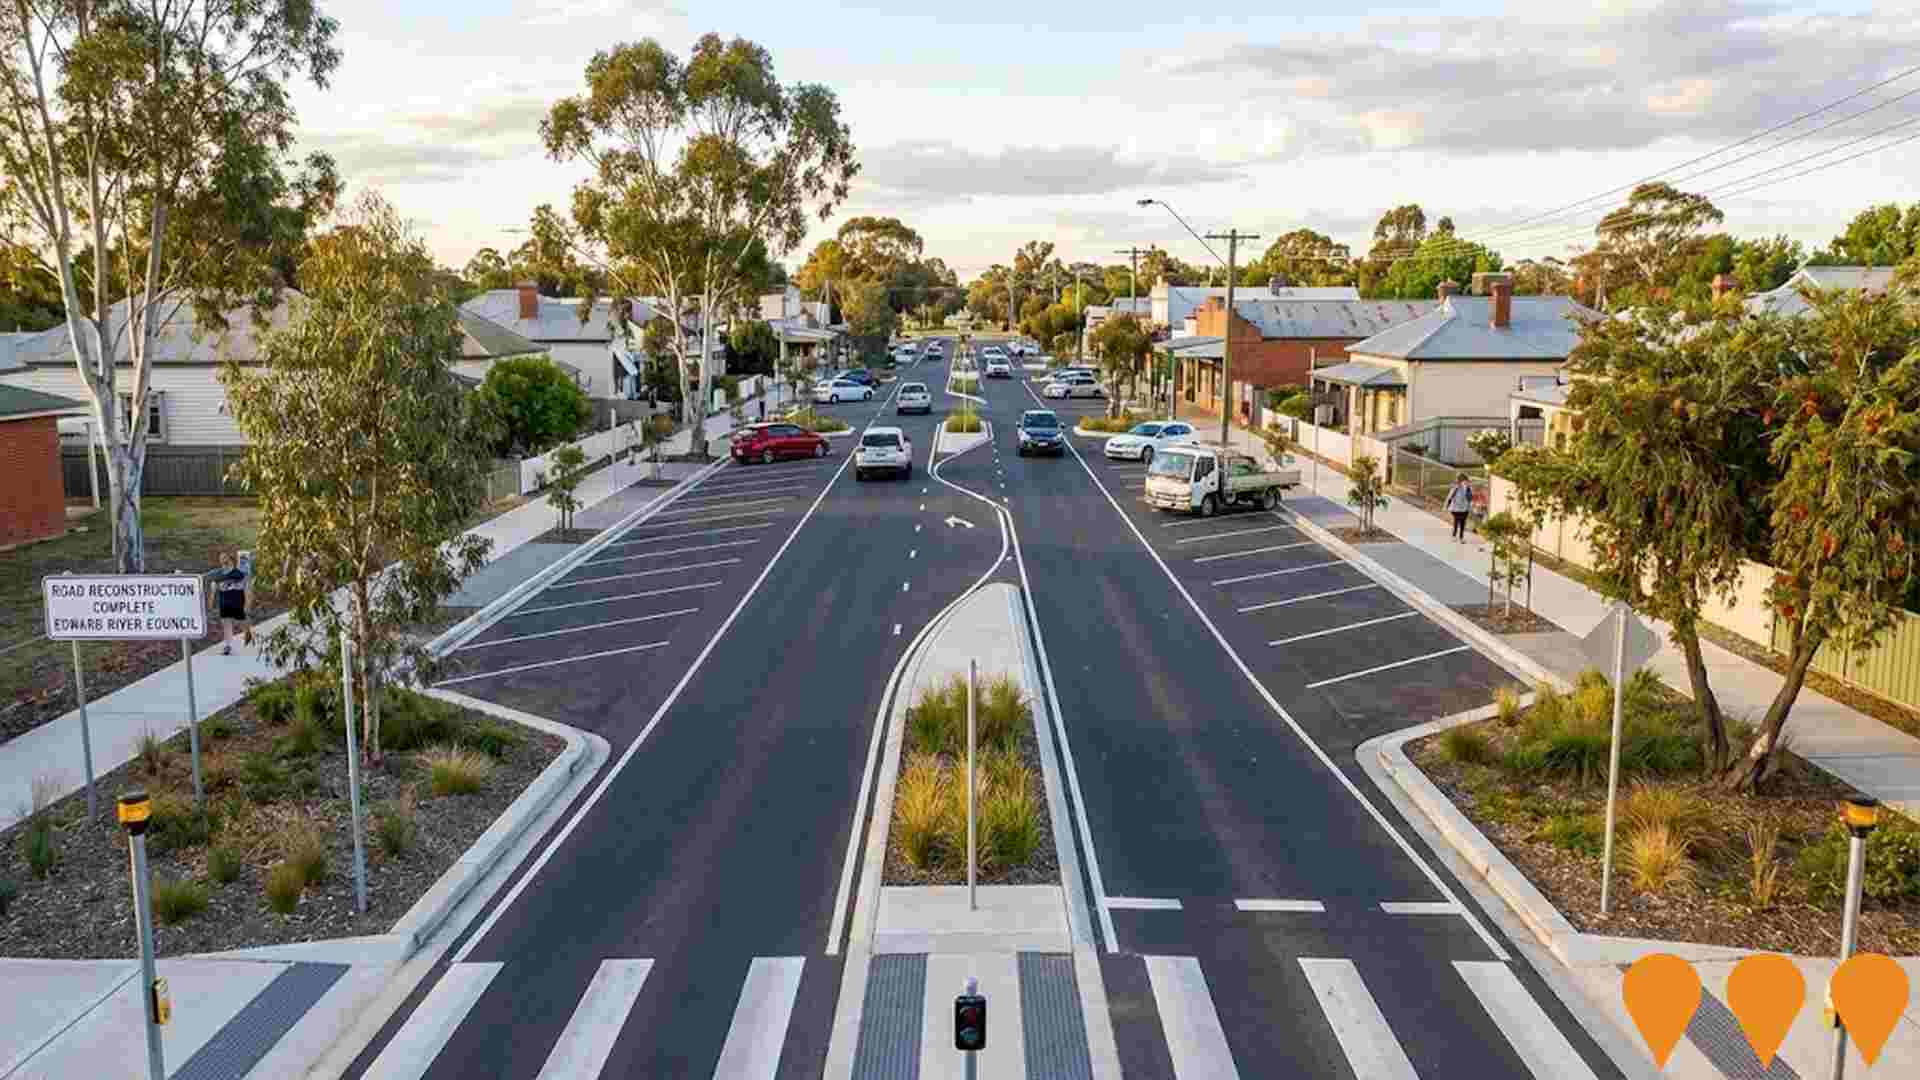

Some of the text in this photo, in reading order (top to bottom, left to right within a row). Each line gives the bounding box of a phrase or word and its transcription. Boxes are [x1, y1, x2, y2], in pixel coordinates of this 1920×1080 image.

[51, 584, 194, 597] ROAD RECONSTRUCTION
[93, 601, 155, 614] COMPLETE
[107, 618, 142, 630] RIVER
